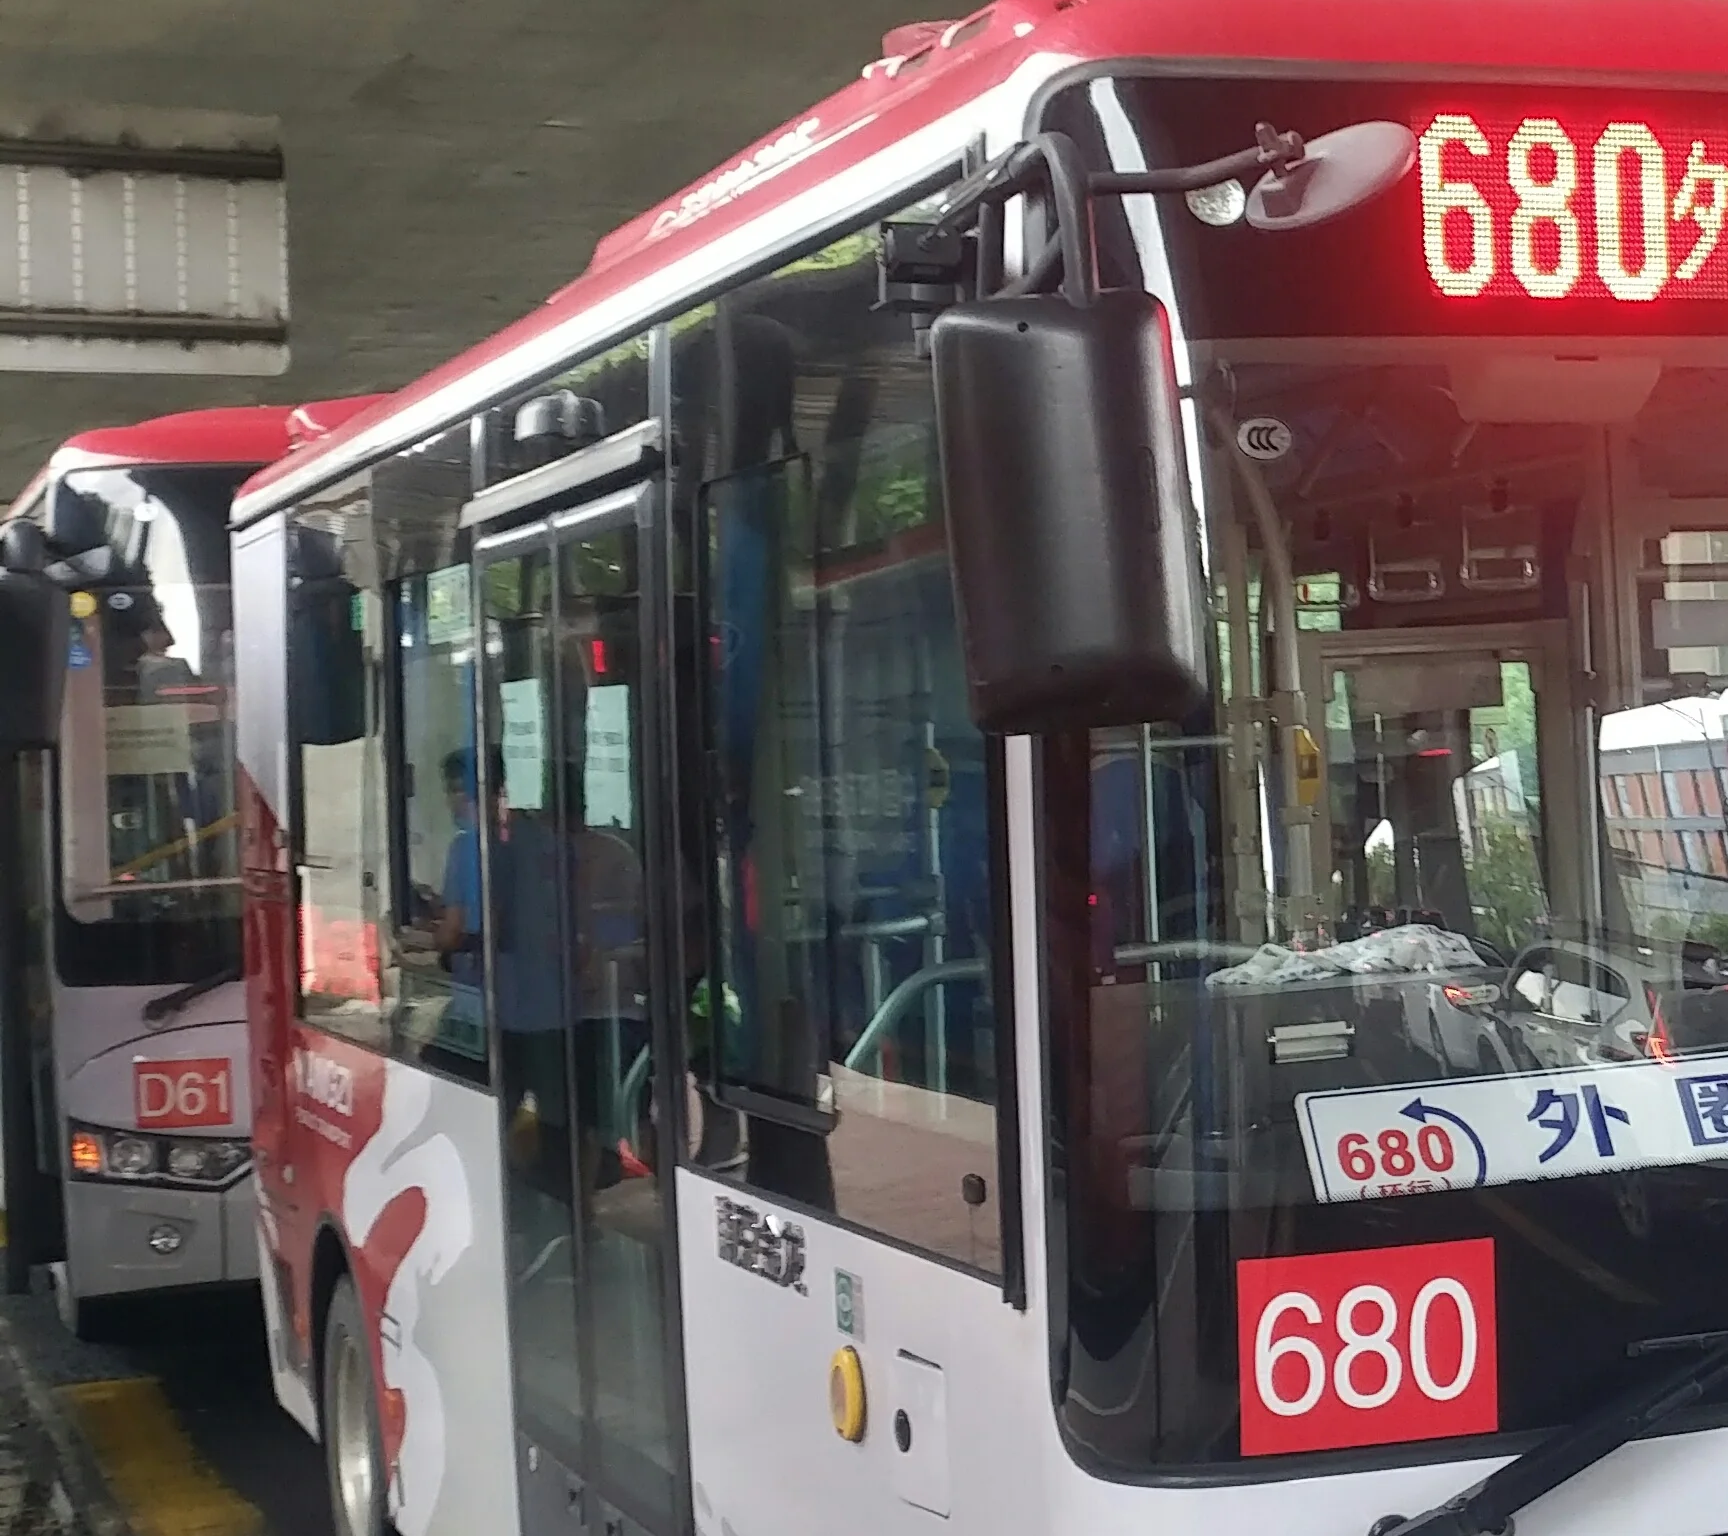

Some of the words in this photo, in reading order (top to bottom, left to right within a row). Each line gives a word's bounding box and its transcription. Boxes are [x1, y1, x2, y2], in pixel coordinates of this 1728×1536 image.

[138, 1070, 229, 1117] D61
[1337, 1125, 1454, 1181] 680
[1254, 1277, 1478, 1417] 680
